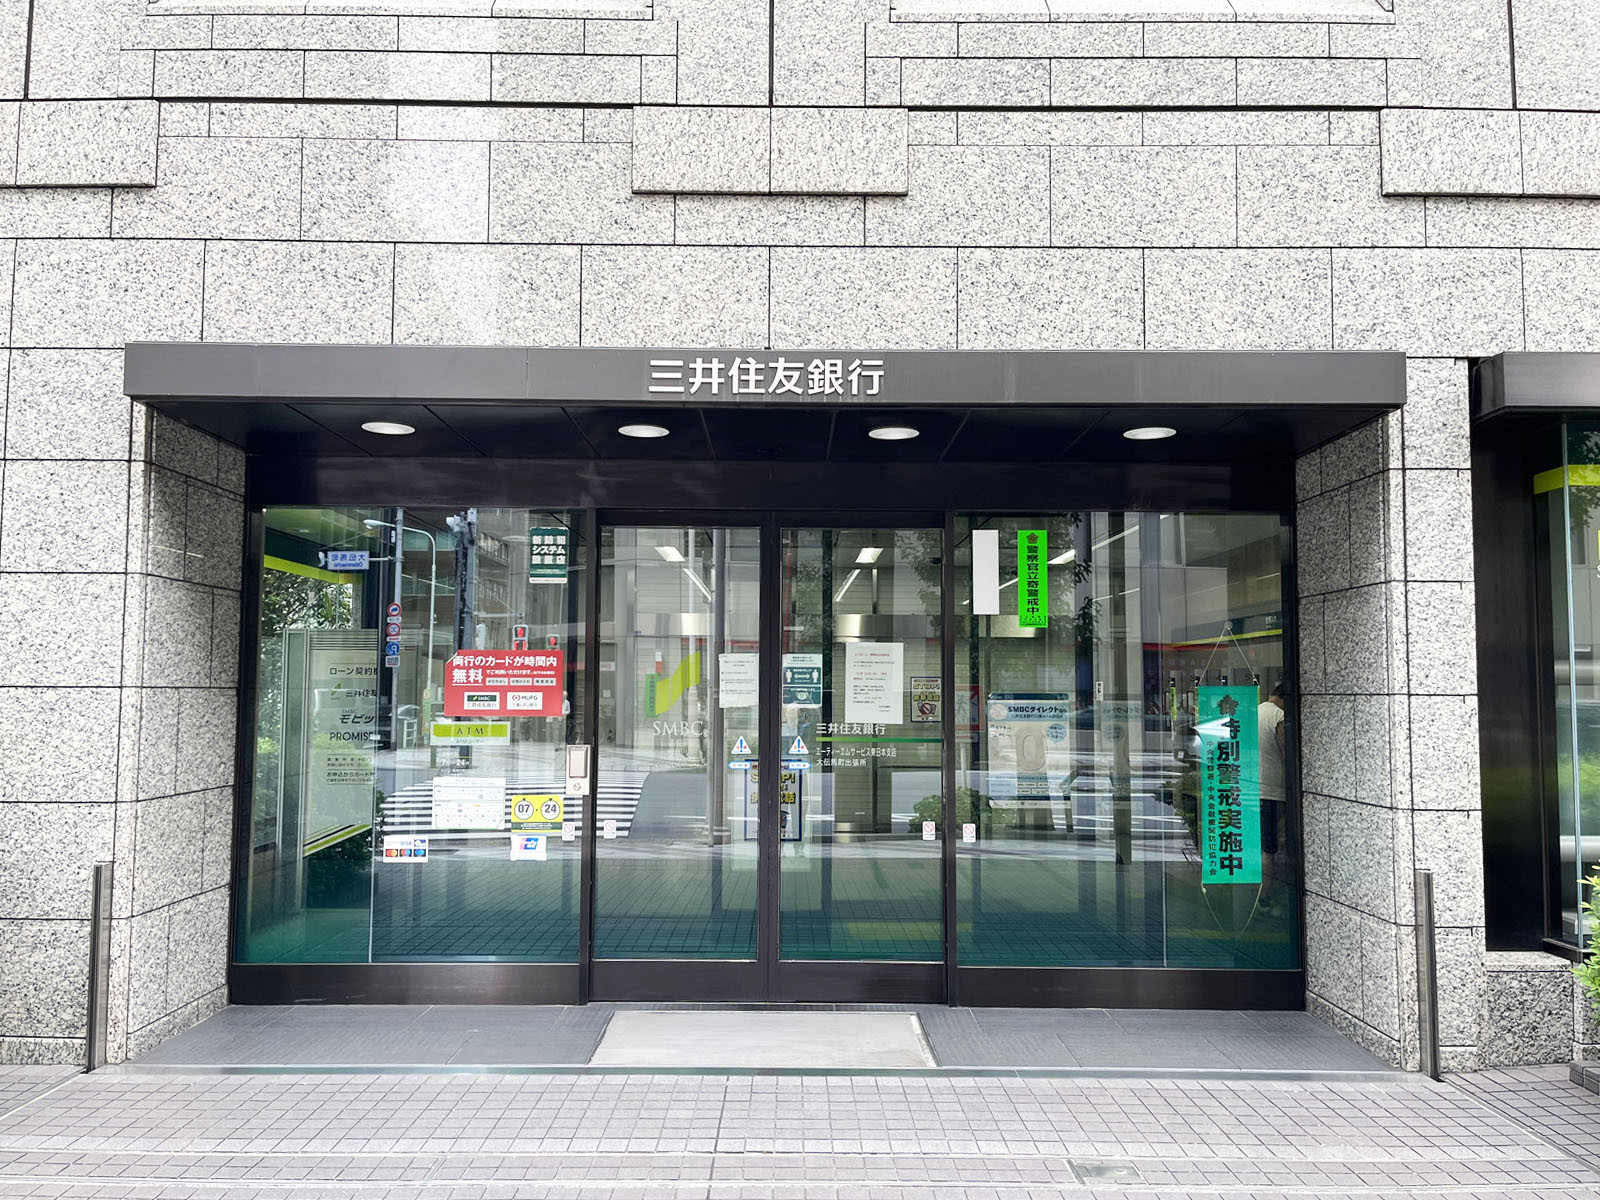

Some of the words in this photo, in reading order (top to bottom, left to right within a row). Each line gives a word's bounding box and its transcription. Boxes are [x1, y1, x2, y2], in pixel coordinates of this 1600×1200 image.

[649, 357, 884, 395] 三井住友銀行
[532, 545, 566, 554] システム
[1027, 545, 1039, 614] 警察官立寄警戒中
[452, 655, 557, 667] 両行のカードが時間内
[452, 668, 483, 683] 無料
[456, 727, 484, 735] ATM
[652, 720, 703, 736] SMBC
[815, 722, 887, 735] 三井住友銀行
[518, 804, 530, 813] 07
[544, 804, 557, 813] 24
